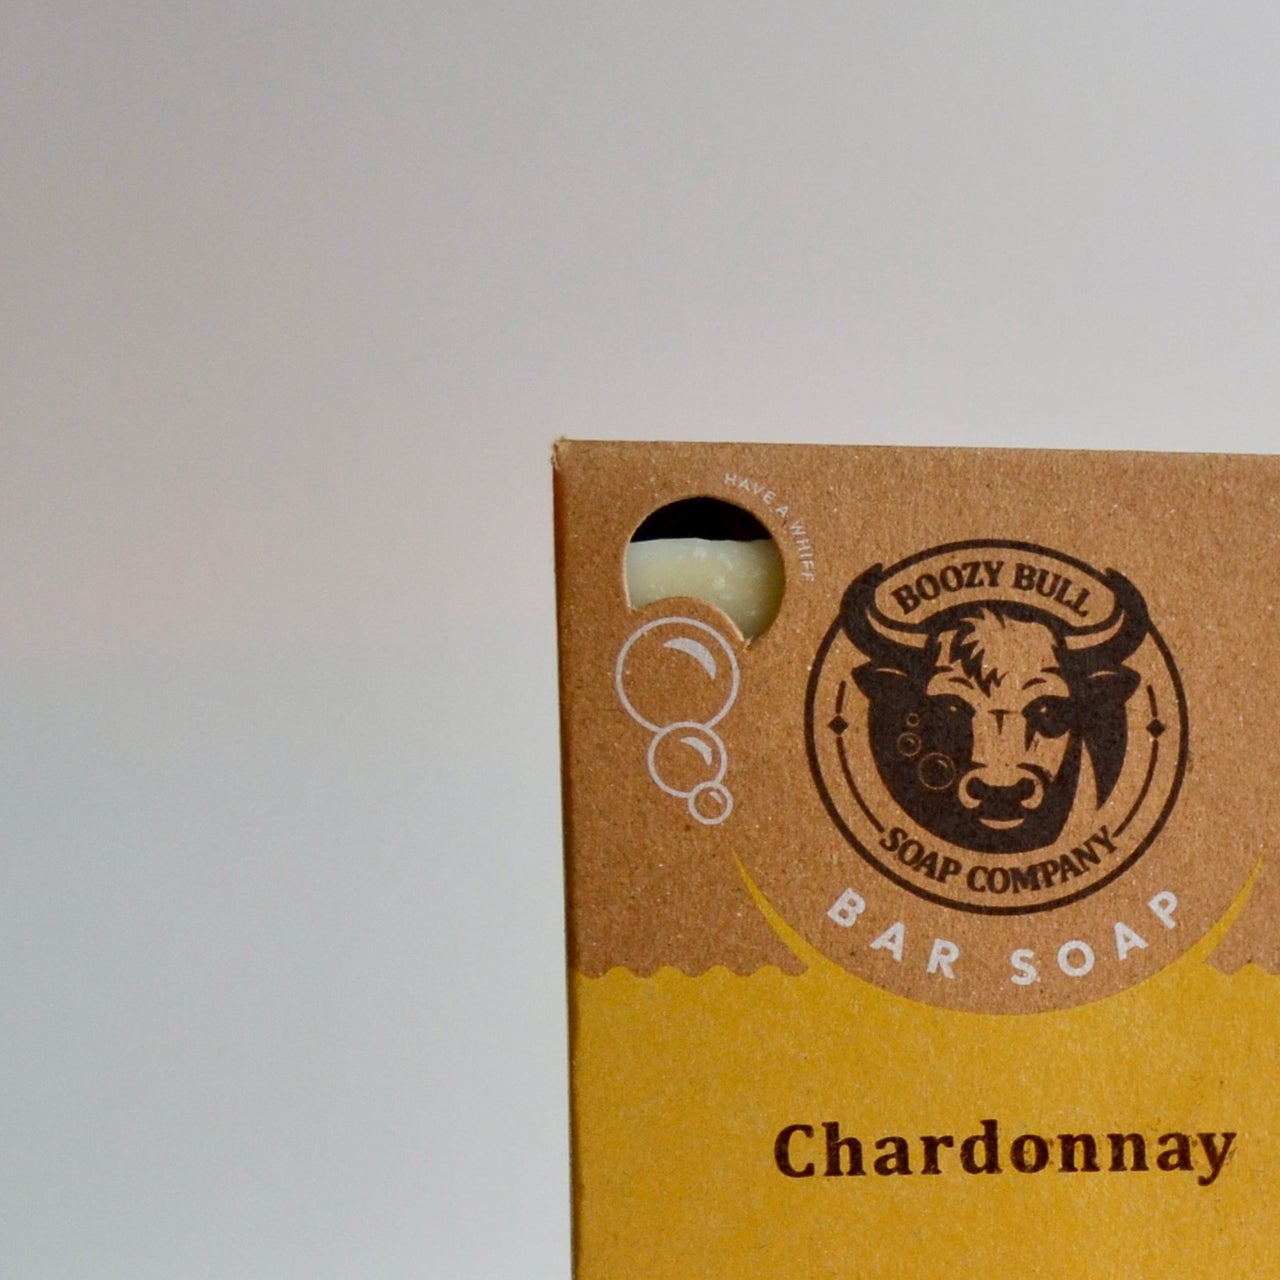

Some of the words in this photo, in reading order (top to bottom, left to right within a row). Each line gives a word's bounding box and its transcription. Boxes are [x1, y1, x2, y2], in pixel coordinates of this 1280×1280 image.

[723, 472, 776, 505] HAVE
[775, 504, 789, 519] A
[788, 520, 815, 582] WHIFF
[890, 560, 1005, 615] BOOZY
[1011, 562, 1091, 617] BULL
[879, 826, 962, 884] SOAP
[966, 825, 1118, 894] COMPANY
[826, 887, 961, 980] BAR
[1010, 890, 1179, 987] SOAP
[773, 1119, 1237, 1187] Chardonnay
